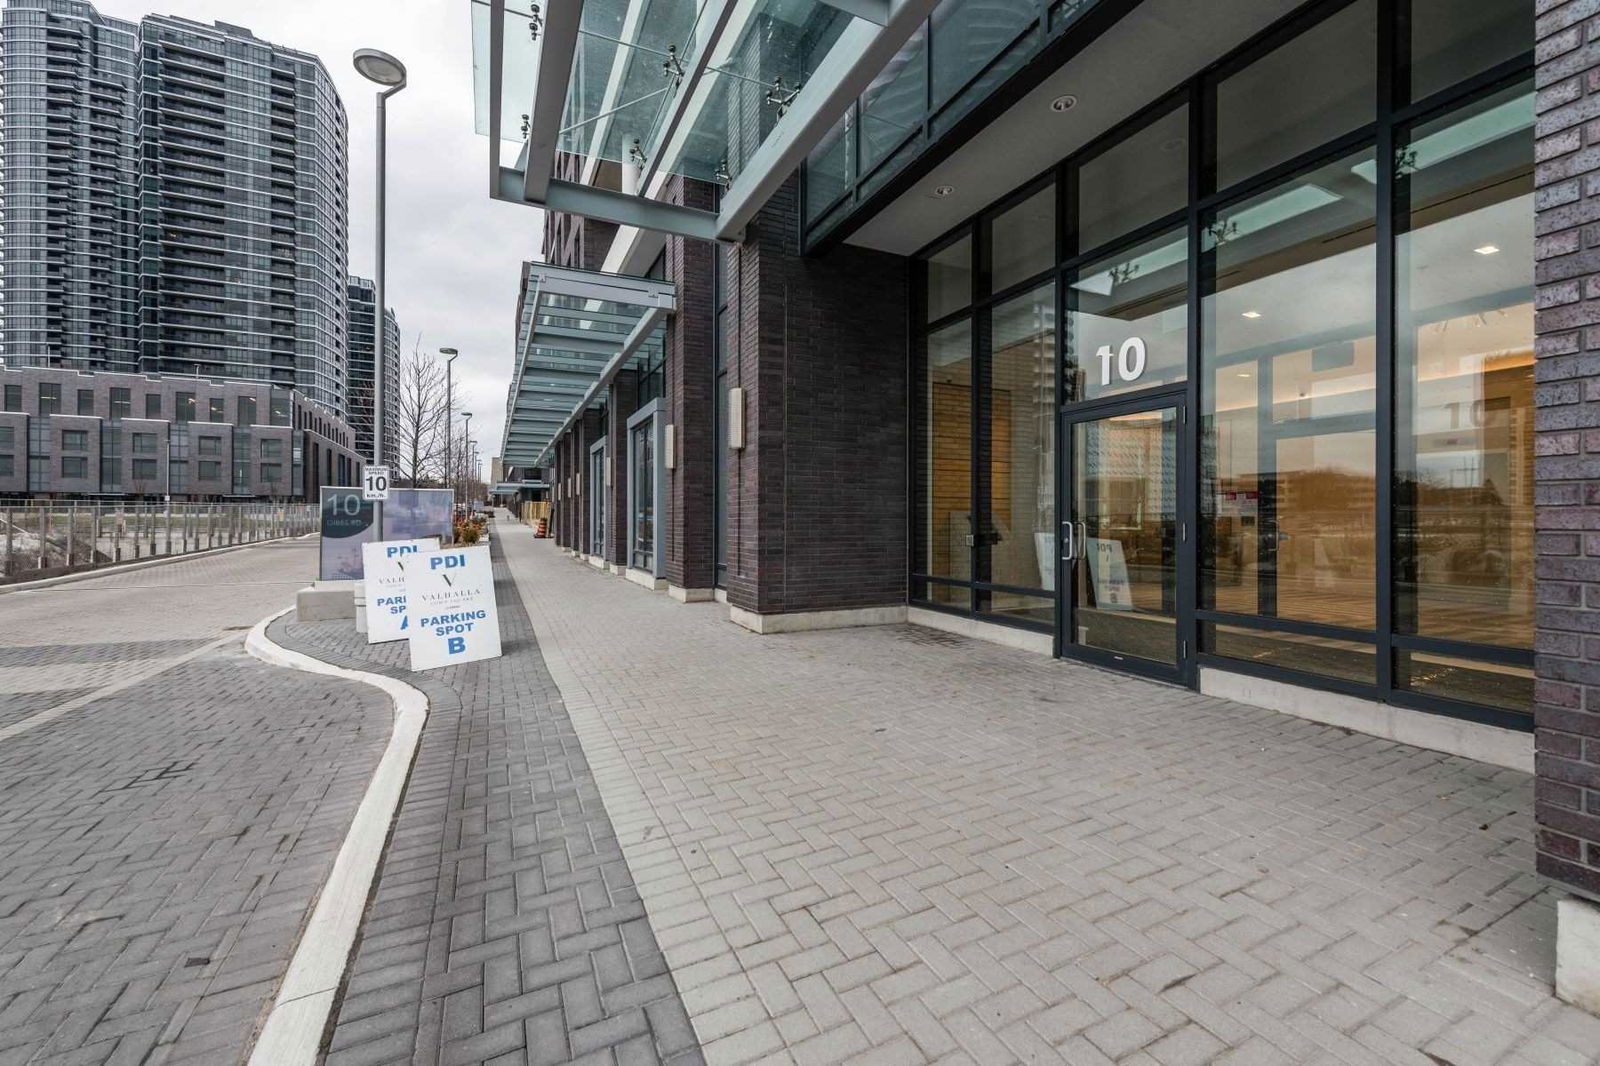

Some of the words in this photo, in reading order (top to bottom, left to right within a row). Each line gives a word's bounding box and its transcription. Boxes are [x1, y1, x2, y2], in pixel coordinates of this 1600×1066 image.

[1096, 336, 1146, 386] 10
[365, 476, 387, 491] 10
[327, 494, 360, 516] 10
[387, 545, 418, 558] PDI
[430, 554, 466, 569] PDI
[421, 588, 481, 601] VALHALLA
[420, 610, 487, 627] PARKING
[436, 622, 474, 636] SPOT
[447, 636, 467, 655] B
